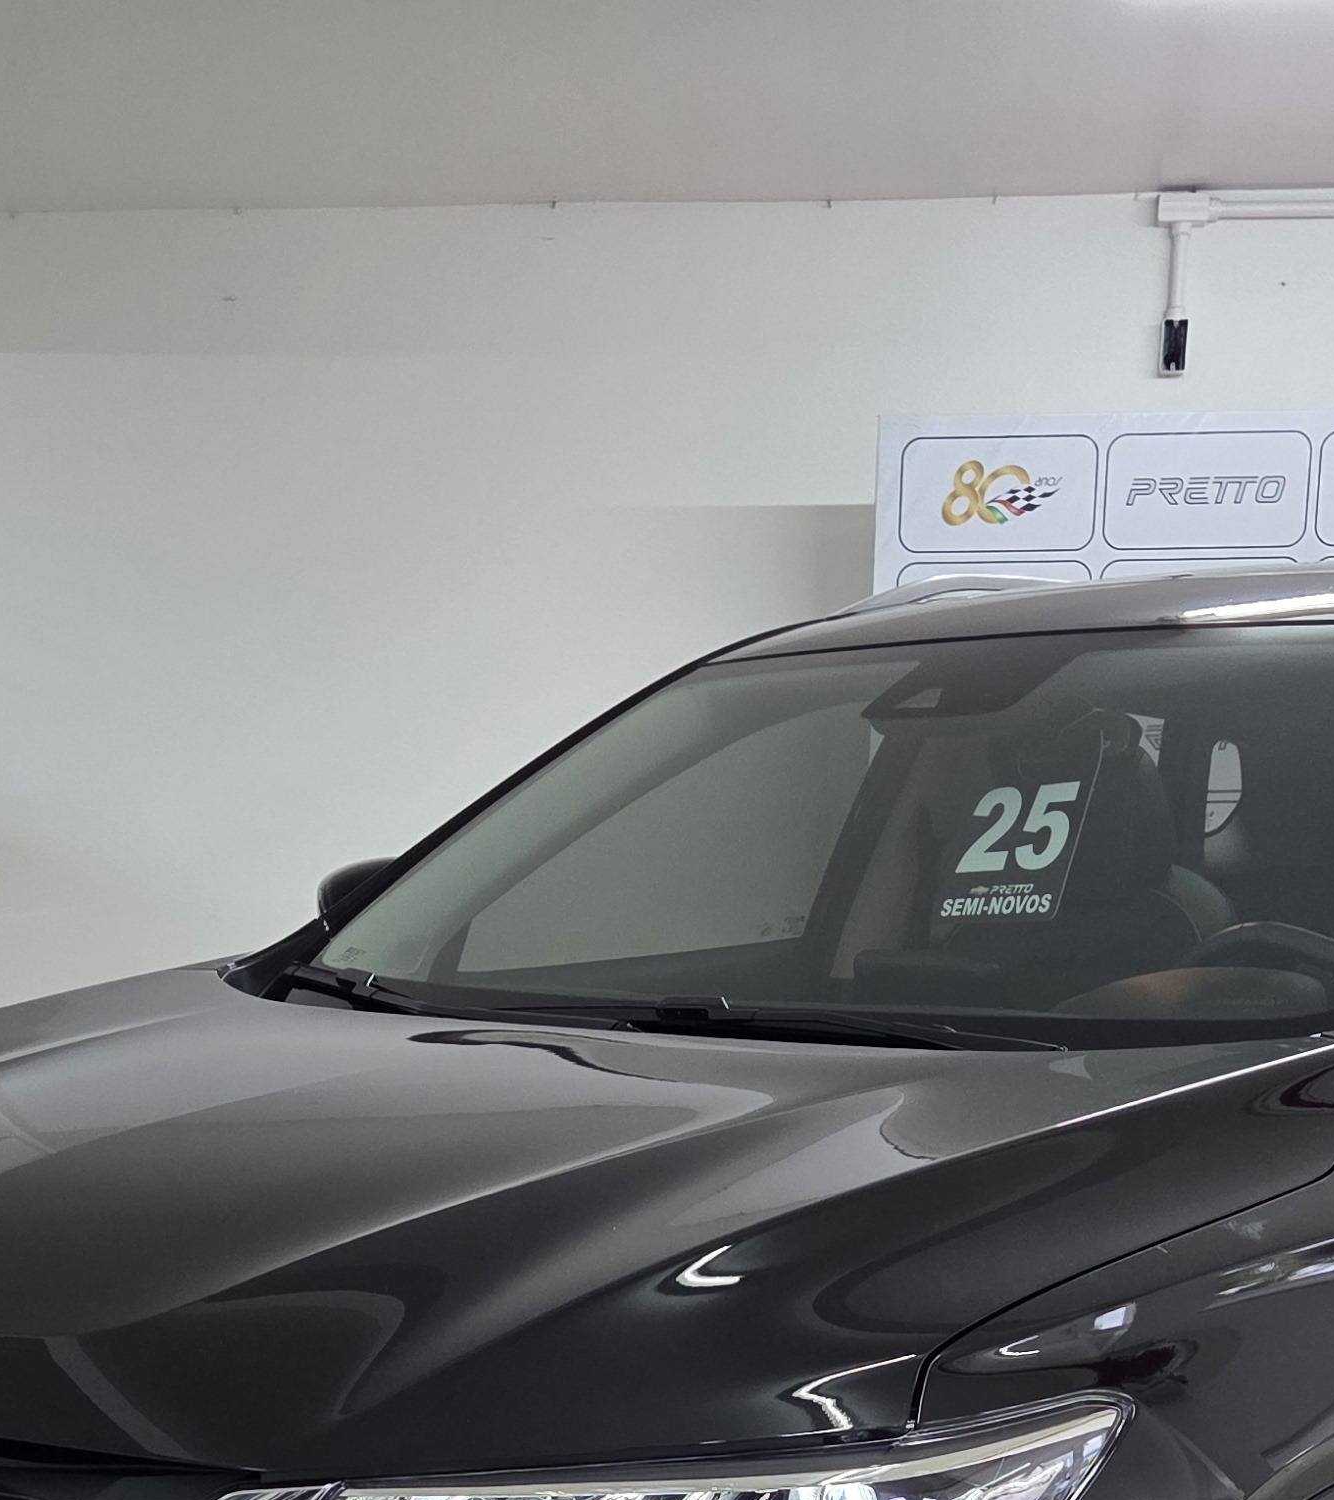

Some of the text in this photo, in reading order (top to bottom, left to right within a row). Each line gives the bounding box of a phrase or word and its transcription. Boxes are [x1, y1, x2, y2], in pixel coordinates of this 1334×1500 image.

[942, 460, 1031, 526] 80
[1126, 475, 1286, 506] PRETTO
[955, 781, 1081, 873] 25
[989, 883, 1034, 894] PRETTO
[940, 893, 1052, 917] SEMI-NOVOS
